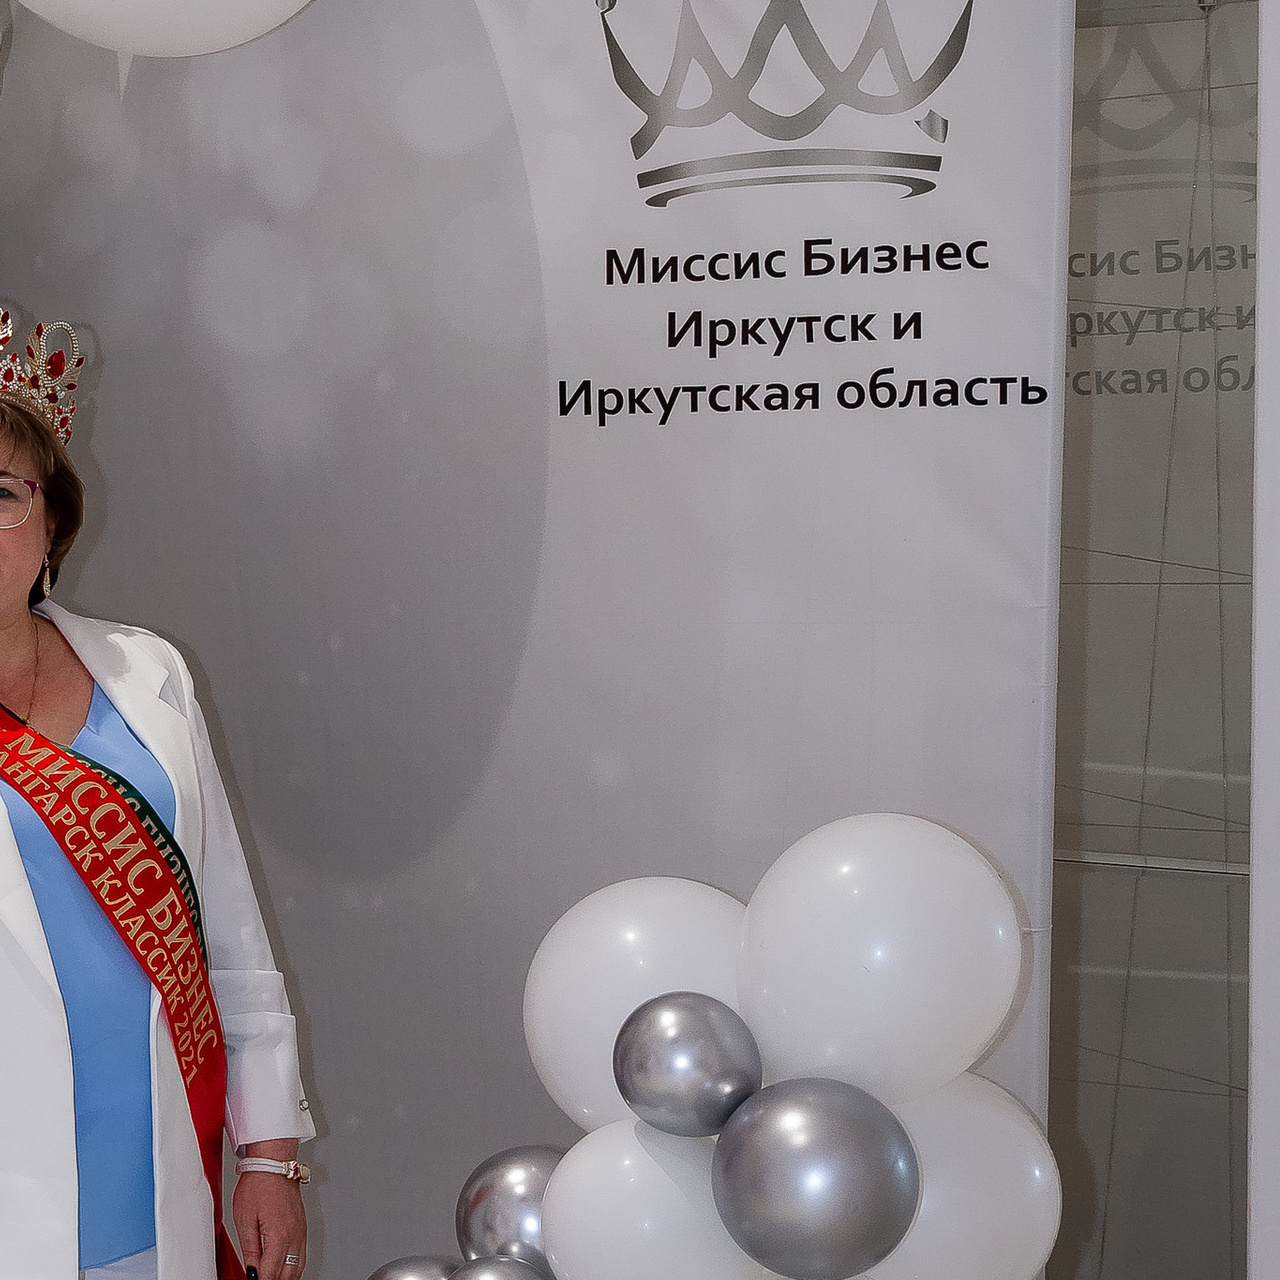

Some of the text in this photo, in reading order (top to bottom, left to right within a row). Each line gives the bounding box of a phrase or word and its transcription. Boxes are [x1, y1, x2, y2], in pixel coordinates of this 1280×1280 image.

[607, 239, 989, 285] Миссис Бизнес
[668, 311, 921, 358] Иркутск и
[559, 368, 1047, 426] Иркутская область
[1065, 367, 1168, 395] ская
[4, 732, 164, 896] МИССИС
[146, 887, 217, 1065] БИЗНЕС
[91, 866, 186, 1015] КЛАССИК
[173, 1011, 198, 1089] 2021
